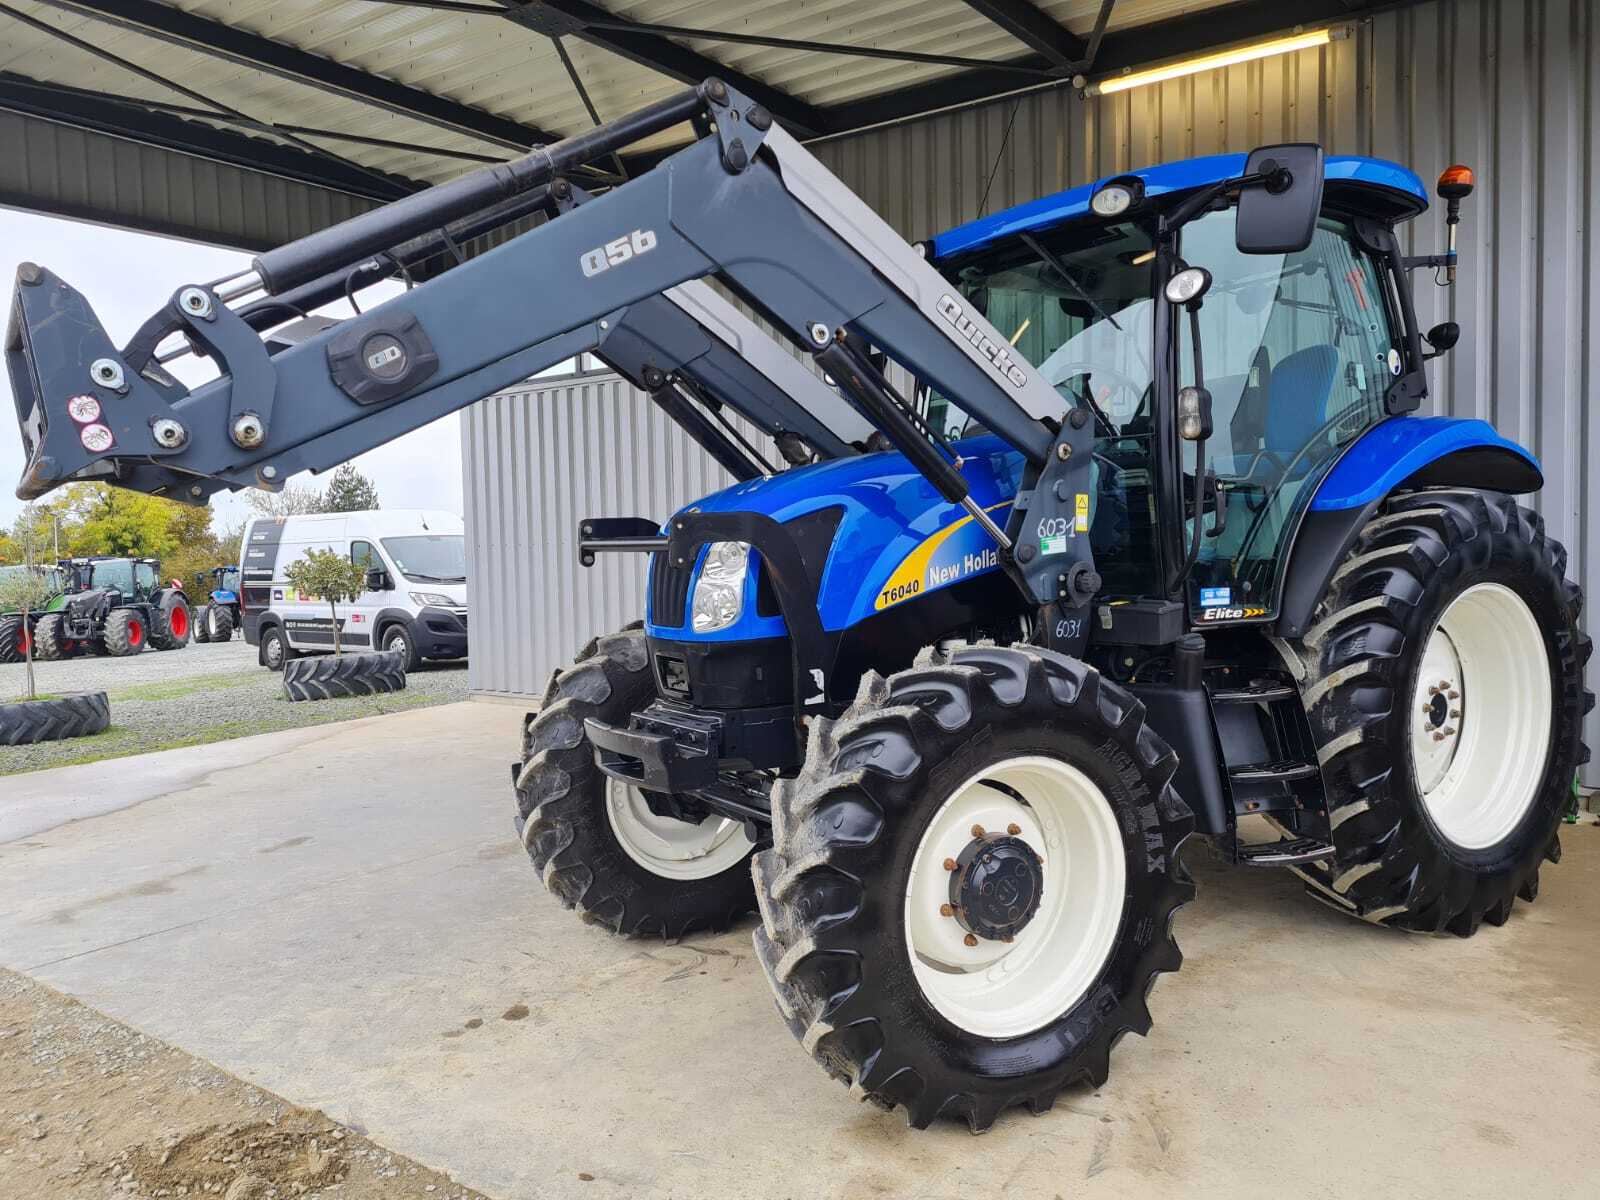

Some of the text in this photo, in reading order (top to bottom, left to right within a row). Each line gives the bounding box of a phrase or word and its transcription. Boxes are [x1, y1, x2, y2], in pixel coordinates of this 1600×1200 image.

[936, 293, 1028, 389] Quicke
[1037, 516, 1076, 538] 6031
[928, 563, 960, 586] New
[882, 580, 919, 605] T6040
[1203, 607, 1243, 620] Elite
[1055, 619, 1082, 638] 6031
